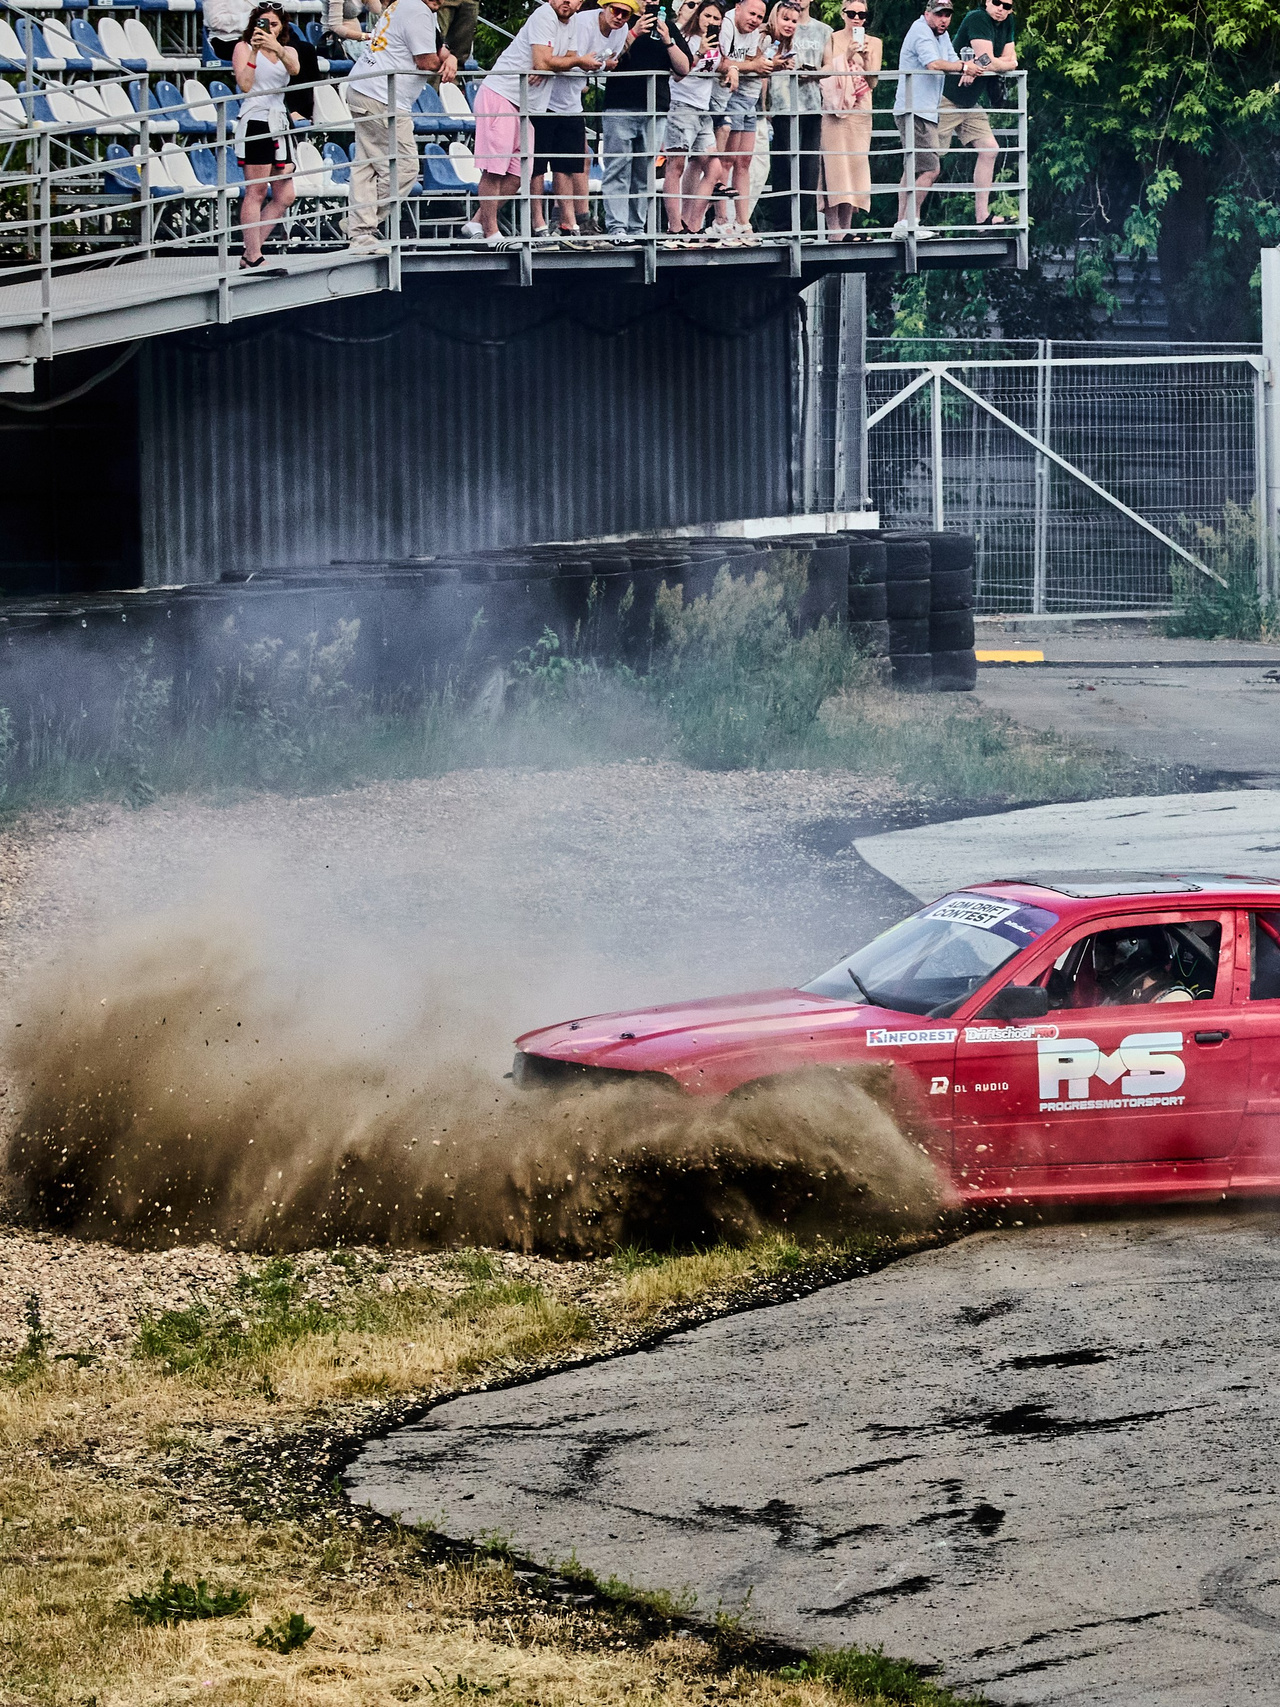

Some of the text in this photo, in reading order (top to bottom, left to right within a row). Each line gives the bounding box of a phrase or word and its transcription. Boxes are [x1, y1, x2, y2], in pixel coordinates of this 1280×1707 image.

[948, 900, 1010, 915] ADM DRIFT
[932, 909, 998, 923] CONTEST
[869, 1030, 955, 1044] KINFOREST
[974, 1082, 1009, 1092] AUDIO
[1039, 1096, 1186, 1112] PROGRESSMOTORSPORT
